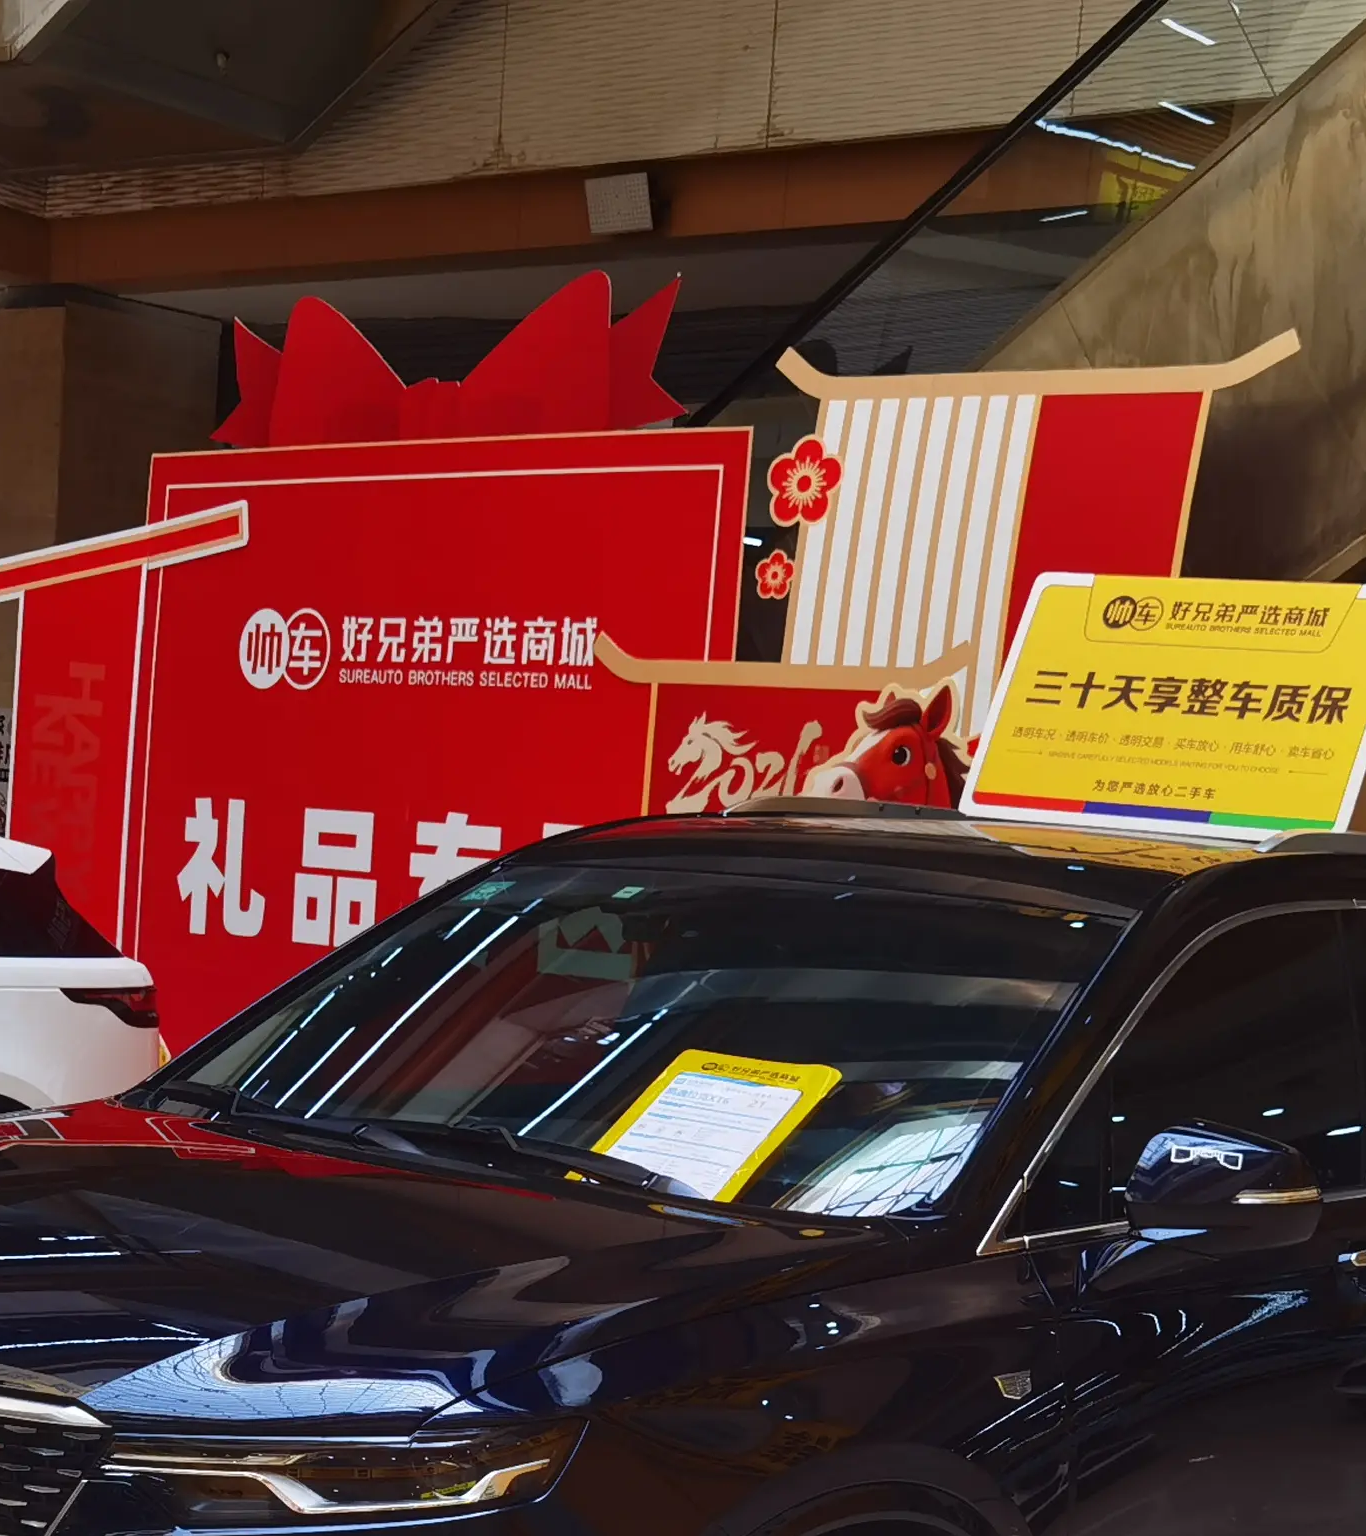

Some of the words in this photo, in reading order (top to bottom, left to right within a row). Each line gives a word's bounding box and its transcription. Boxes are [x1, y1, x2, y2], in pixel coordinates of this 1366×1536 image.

[1104, 597, 1162, 629] 帅车
[1168, 601, 1331, 628] 好兄弟严选商城
[242, 613, 327, 684] 帅车
[340, 616, 598, 667] 好兄弟严选商城
[338, 668, 404, 686] SUREAUTO
[408, 670, 475, 687] BROTHERS
[479, 671, 549, 689] SELECTED
[554, 673, 592, 691] MALL
[1025, 669, 1353, 726] 三十天享整车质保
[176, 797, 583, 947] 礼品专
